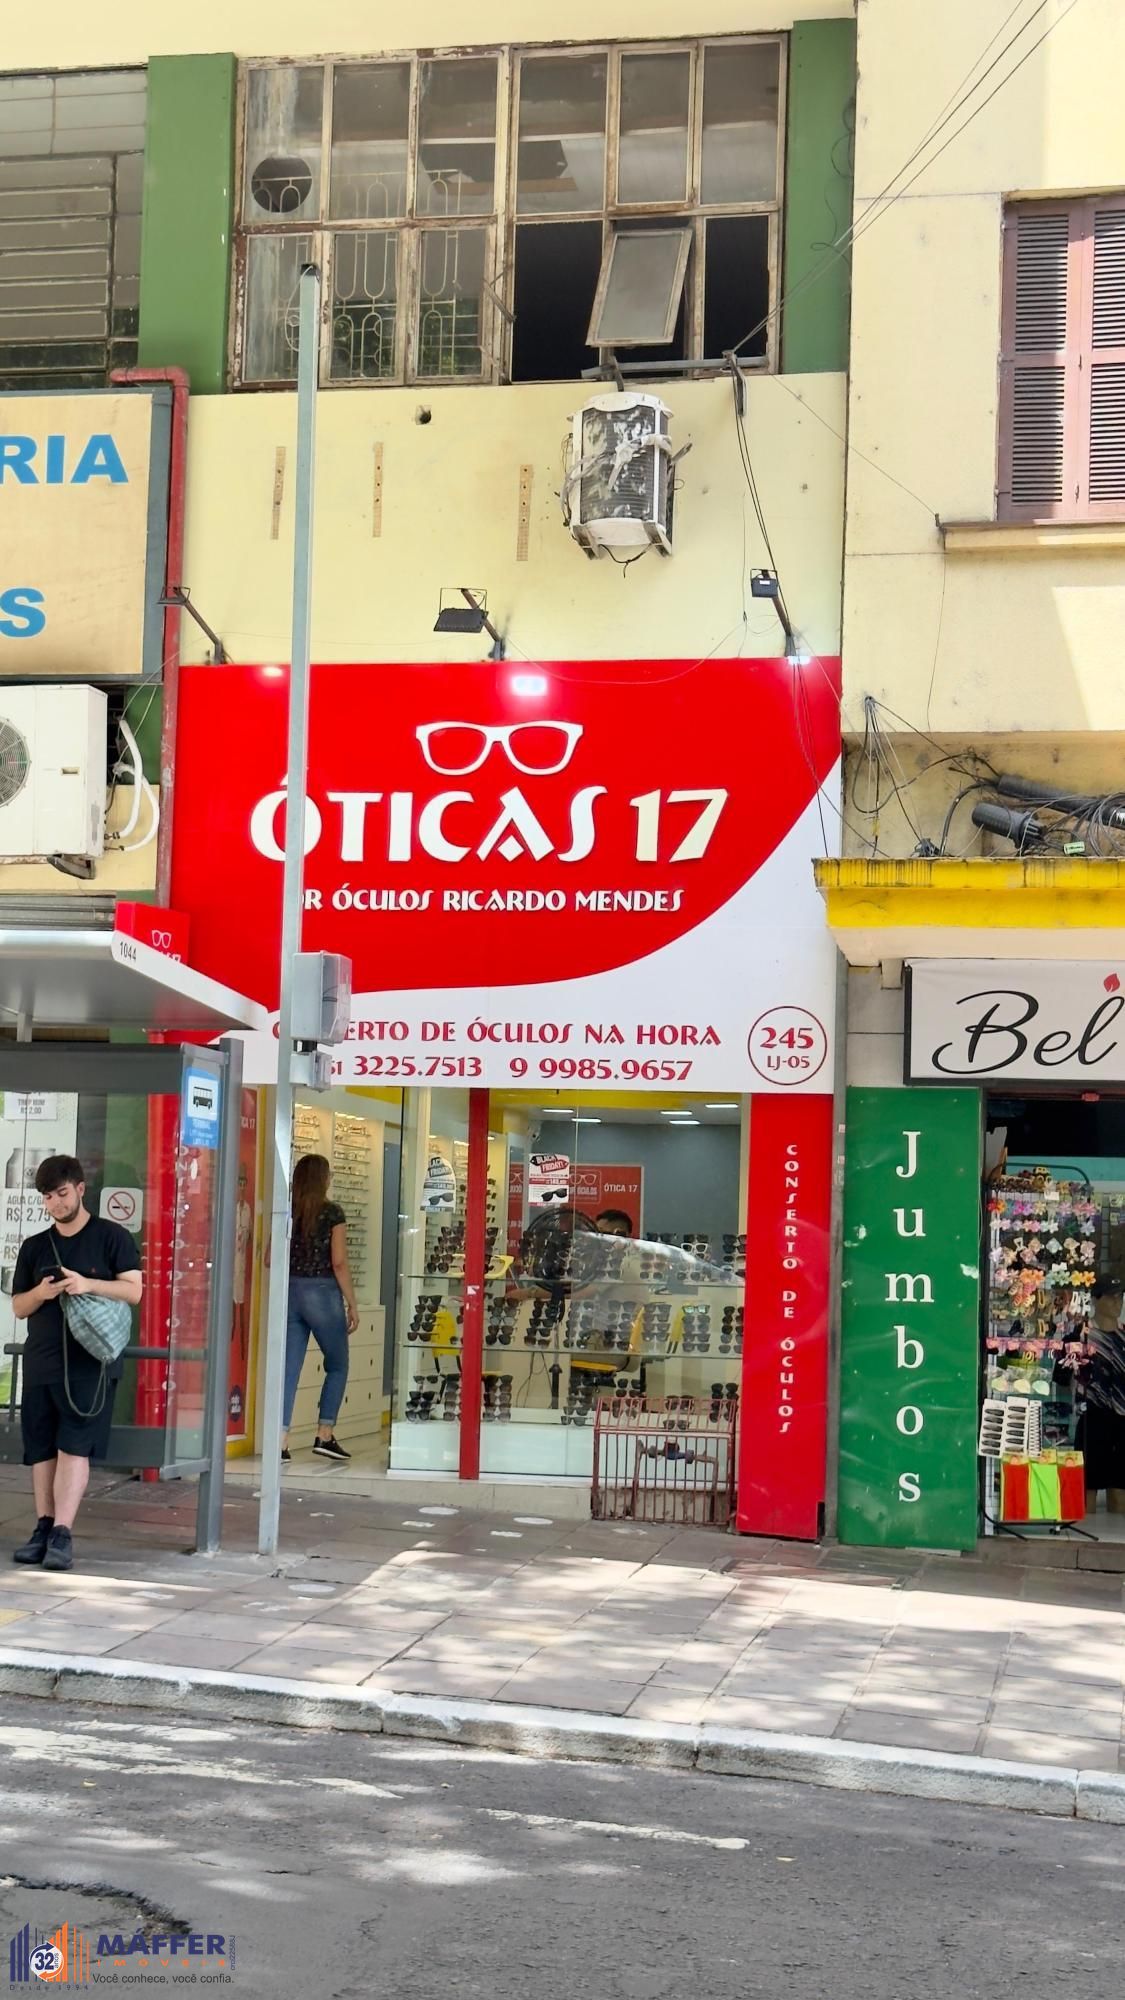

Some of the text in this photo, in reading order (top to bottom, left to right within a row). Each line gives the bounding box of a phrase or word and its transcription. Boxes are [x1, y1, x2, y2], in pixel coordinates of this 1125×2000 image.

[250, 772, 729, 864] ÓTICAS 17
[331, 882, 434, 912] ÓCULOS
[442, 889, 567, 912] RICARDO
[575, 889, 684, 912] MENDES
[119, 941, 137, 961] 1044
[421, 1021, 455, 1042] DE
[466, 1016, 571, 1043] ÓCULOS
[585, 1024, 625, 1044] NA
[636, 1024, 722, 1046] HORA
[760, 1026, 814, 1049] 245
[355, 1056, 483, 1077] 3225.7513
[509, 1058, 529, 1077] 9
[539, 1057, 693, 1081] 9985.9657
[766, 1054, 811, 1070] LJ-05
[603, 1182, 638, 1193] ÓTICA 17
[27, 1207, 51, 1223] 2,75
[778, 1144, 799, 1434] CONSERTO DE ÓCULOS
[885, 1131, 935, 1502] Jumbos
